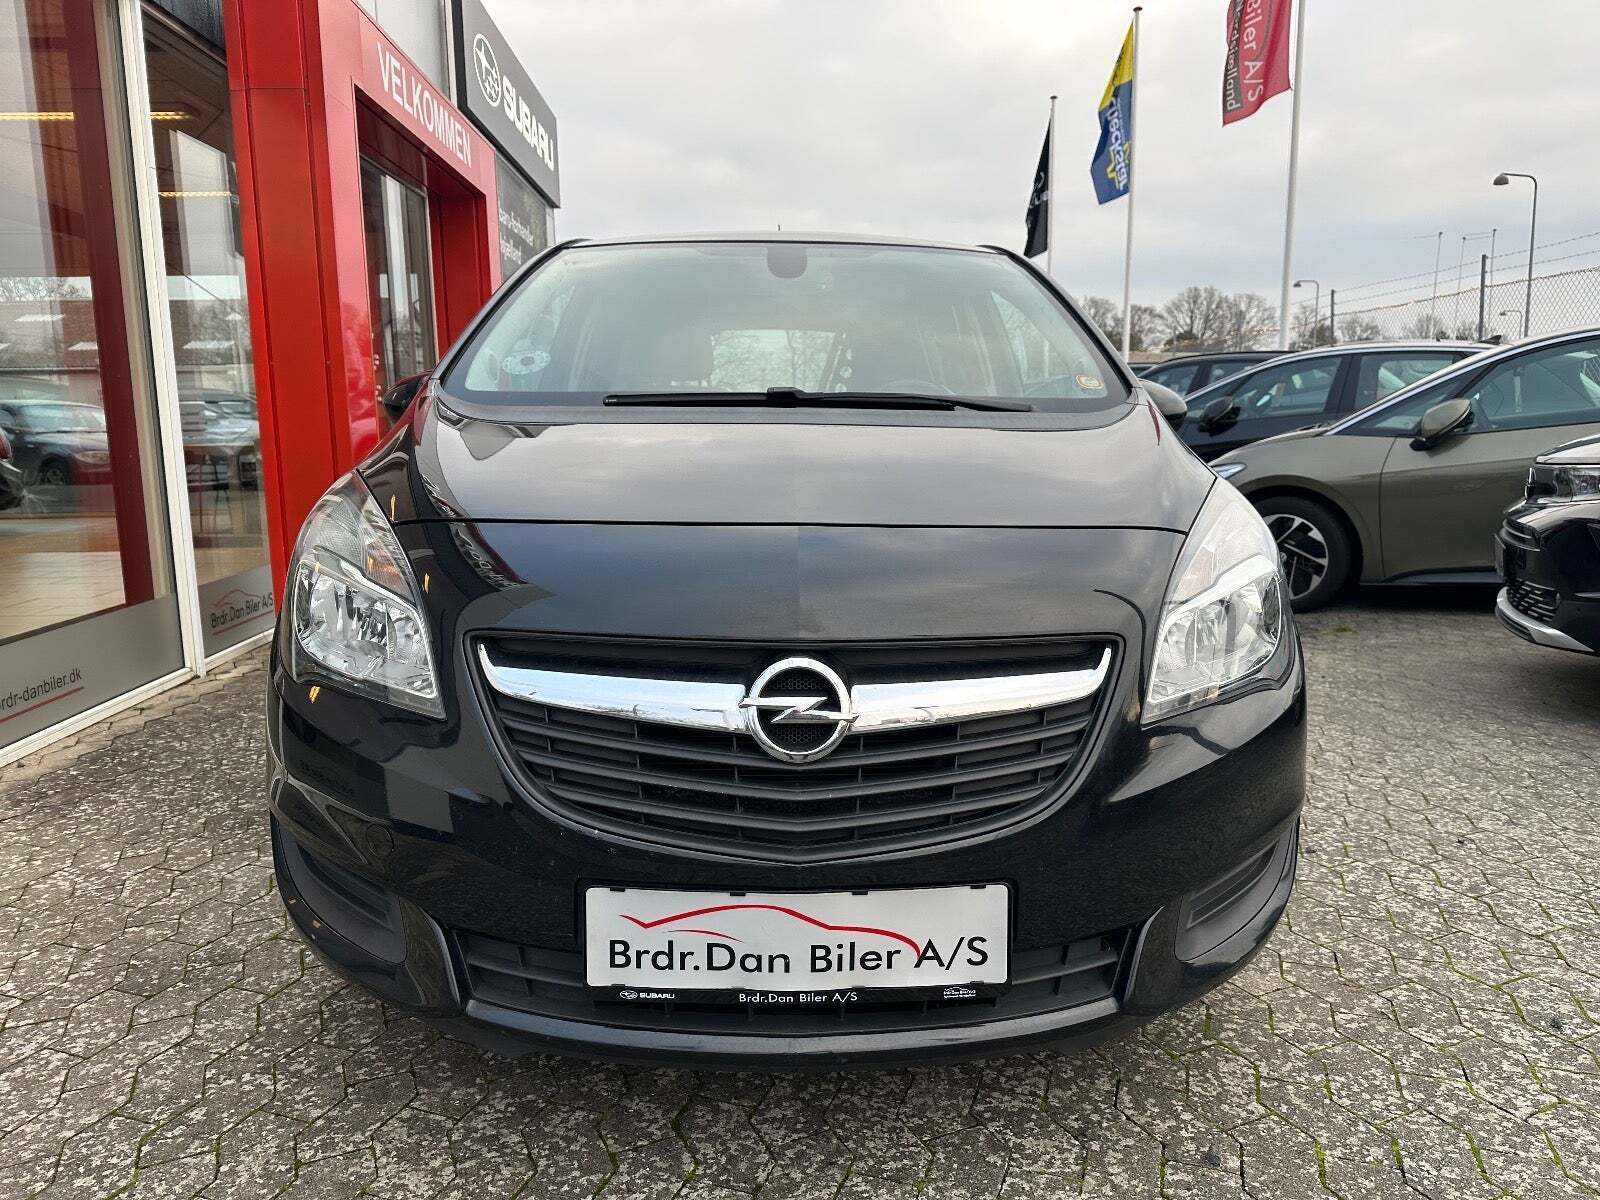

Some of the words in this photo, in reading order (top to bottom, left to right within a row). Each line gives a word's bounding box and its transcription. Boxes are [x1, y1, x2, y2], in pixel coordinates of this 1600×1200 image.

[1243, 61, 1264, 102] A/S
[376, 41, 472, 169] VELKOMMEN
[502, 75, 555, 171] SUBARU
[0, 668, 82, 711] rdr-danbiler.dk
[609, 939, 790, 974] Brdr.Dan
[810, 942, 901, 973] Biler
[914, 936, 989, 971] A/S
[738, 992, 794, 1003] Brdr.Dan
[799, 993, 828, 1002] Biler
[832, 991, 858, 1002] A/S
